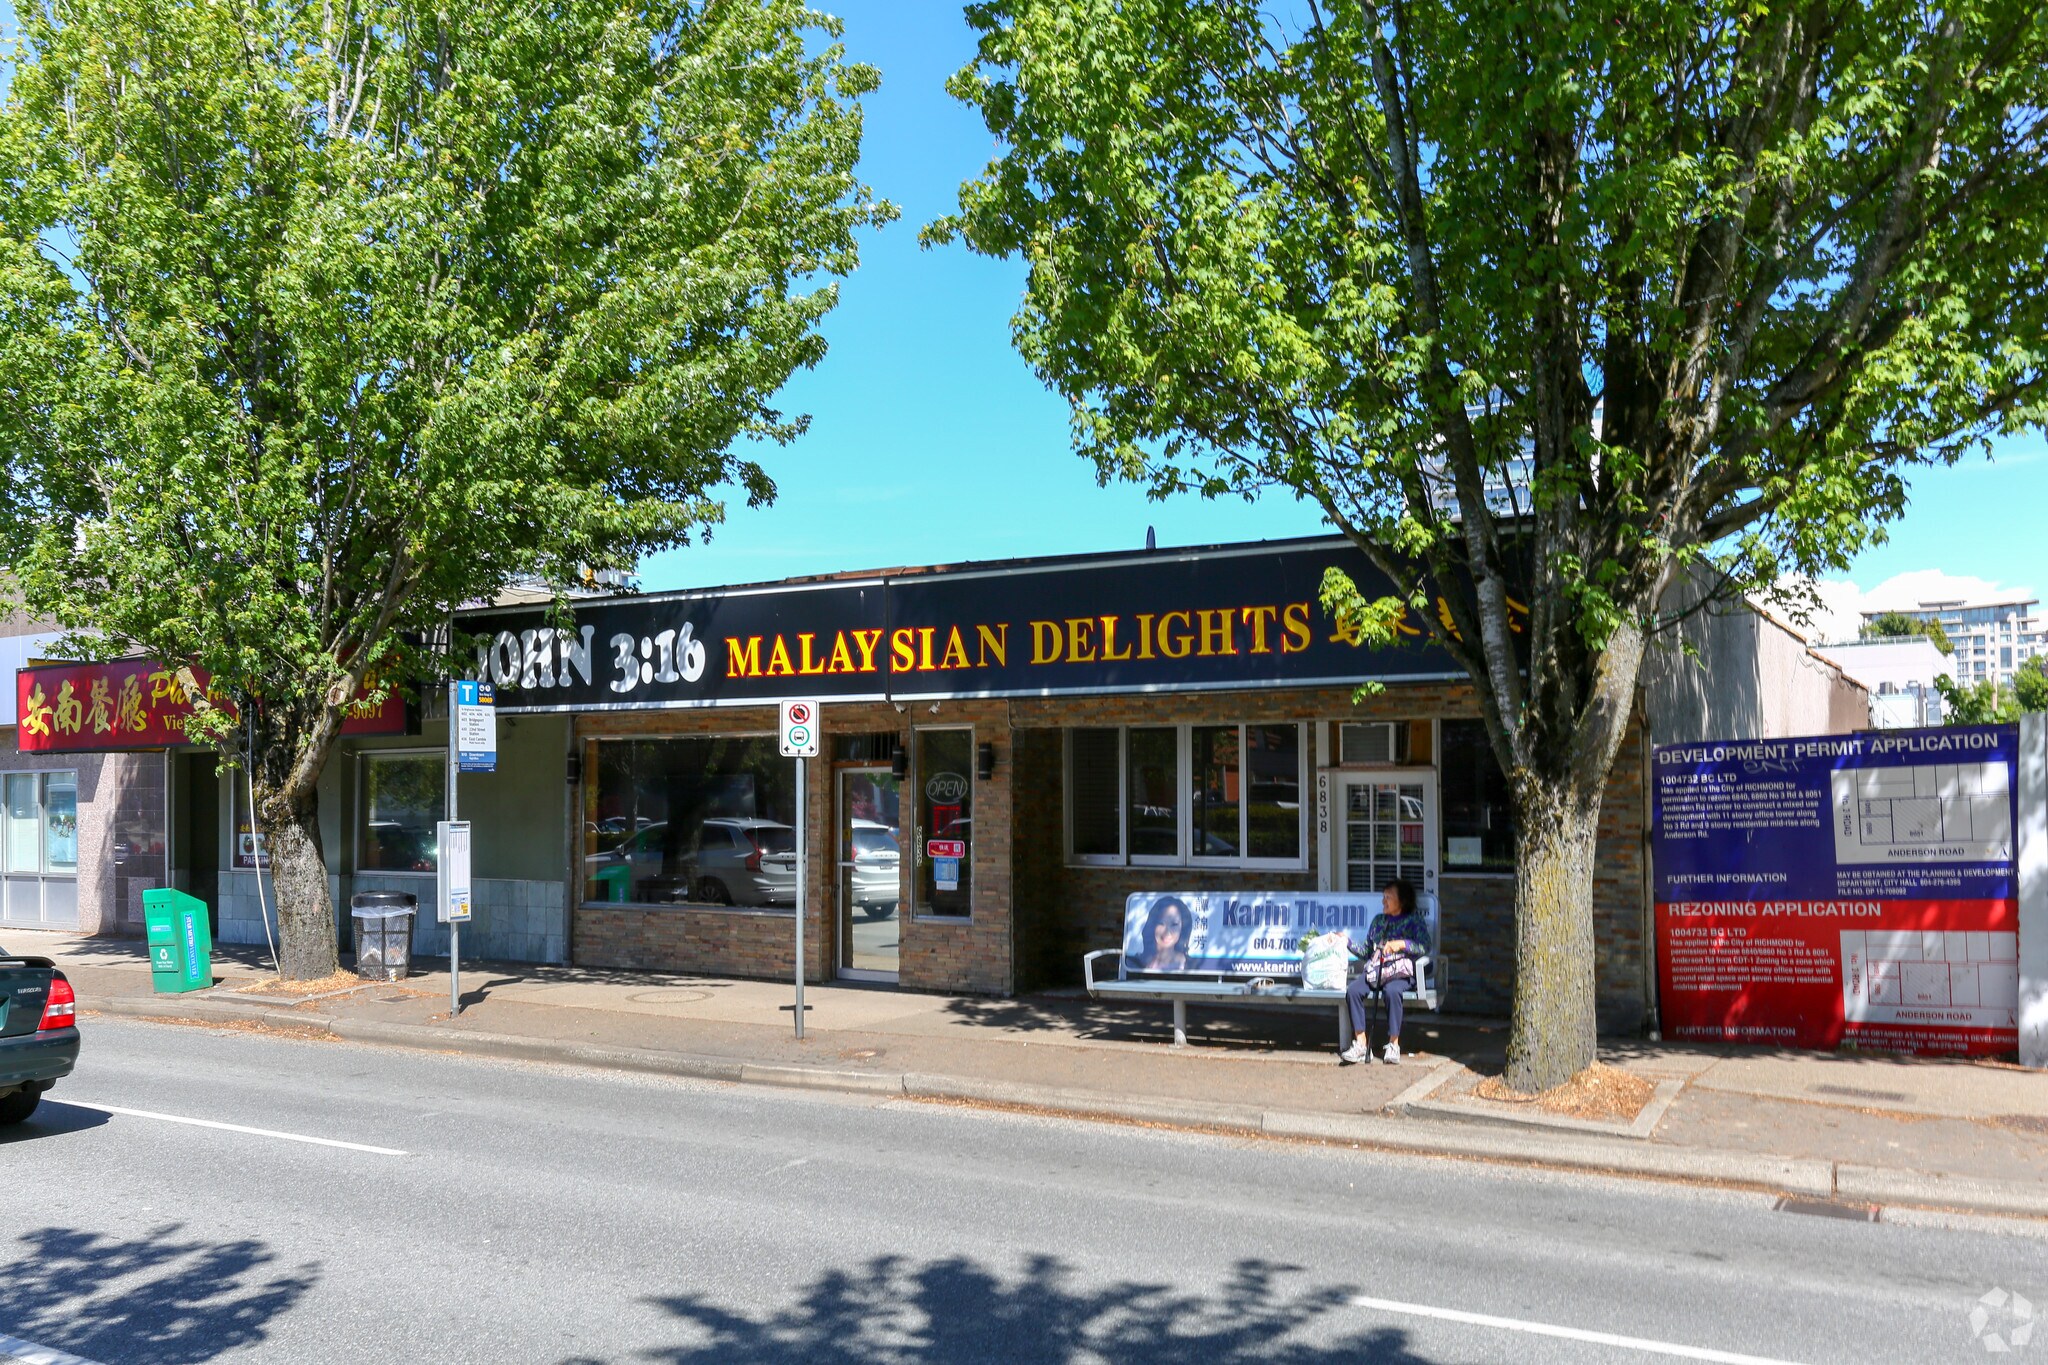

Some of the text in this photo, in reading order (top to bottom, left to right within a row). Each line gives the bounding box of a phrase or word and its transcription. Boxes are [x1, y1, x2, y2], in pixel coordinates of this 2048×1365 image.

[609, 620, 706, 694] 3:16
[724, 622, 1010, 678] MALAYSIAN
[1029, 602, 1312, 665] DELIGHTS
[348, 701, 384, 720] -9097
[1659, 732, 1998, 764] DEVELOPMENT PERMIT APPLICATION
[1661, 773, 1736, 784] 1004732 BC LTD
[928, 780, 964, 796] OPEN
[1661, 786, 1674, 794] Has
[1676, 785, 1699, 795] applied
[1721, 784, 1734, 793] City
[1736, 783, 1743, 791] of
[1745, 782, 1784, 791] RICHMOND
[1786, 782, 1796, 790] for
[1319, 776, 1328, 834] 6838
[1663, 804, 1694, 813] Anderson
[1663, 813, 1705, 822] development
[1732, 812, 1753, 821] storey
[1797, 810, 1816, 819] along
[1888, 848, 1965, 858] ANDERSON ROAD
[244, 856, 269, 864] PARIN
[1964, 868, 2014, 876] DEVELOPMENT
[1667, 873, 1787, 884] FURTHER INFORMATION
[1222, 900, 1367, 928] Karin Tham
[1668, 902, 1882, 916] REZONING APPLICATION
[1670, 928, 1707, 937] 1004732
[1728, 928, 1746, 937] LTD
[1254, 938, 1298, 951] 604.780
[1684, 939, 1708, 947] applied
[1731, 938, 1744, 947] City
[1232, 961, 1302, 974] www.karint
[1756, 958, 1779, 966] Zoning
[1896, 1011, 1972, 1021] ANDERSON ROAD
[1676, 1026, 1796, 1036] FURTHER INFORMATION
[1971, 1035, 2017, 1044] DEVELOPMEN
